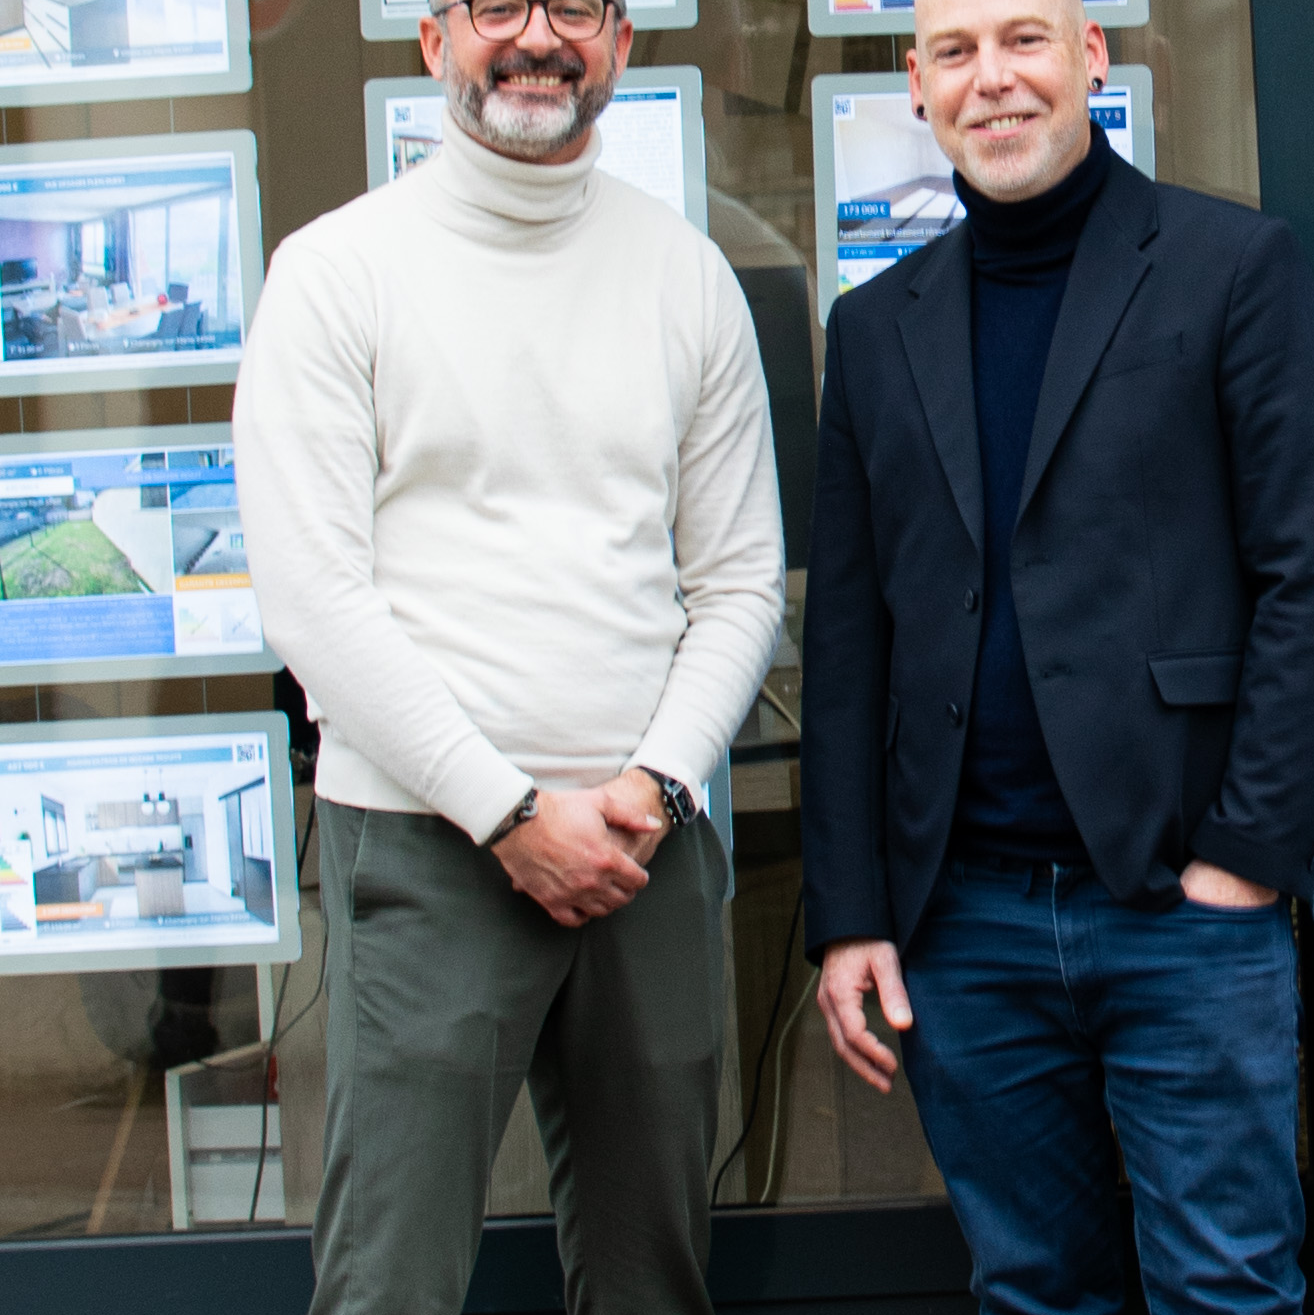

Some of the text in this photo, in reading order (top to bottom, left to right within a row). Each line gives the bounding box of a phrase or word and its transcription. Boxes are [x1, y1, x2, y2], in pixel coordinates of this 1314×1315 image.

[843, 202, 886, 216] 173 000 €
